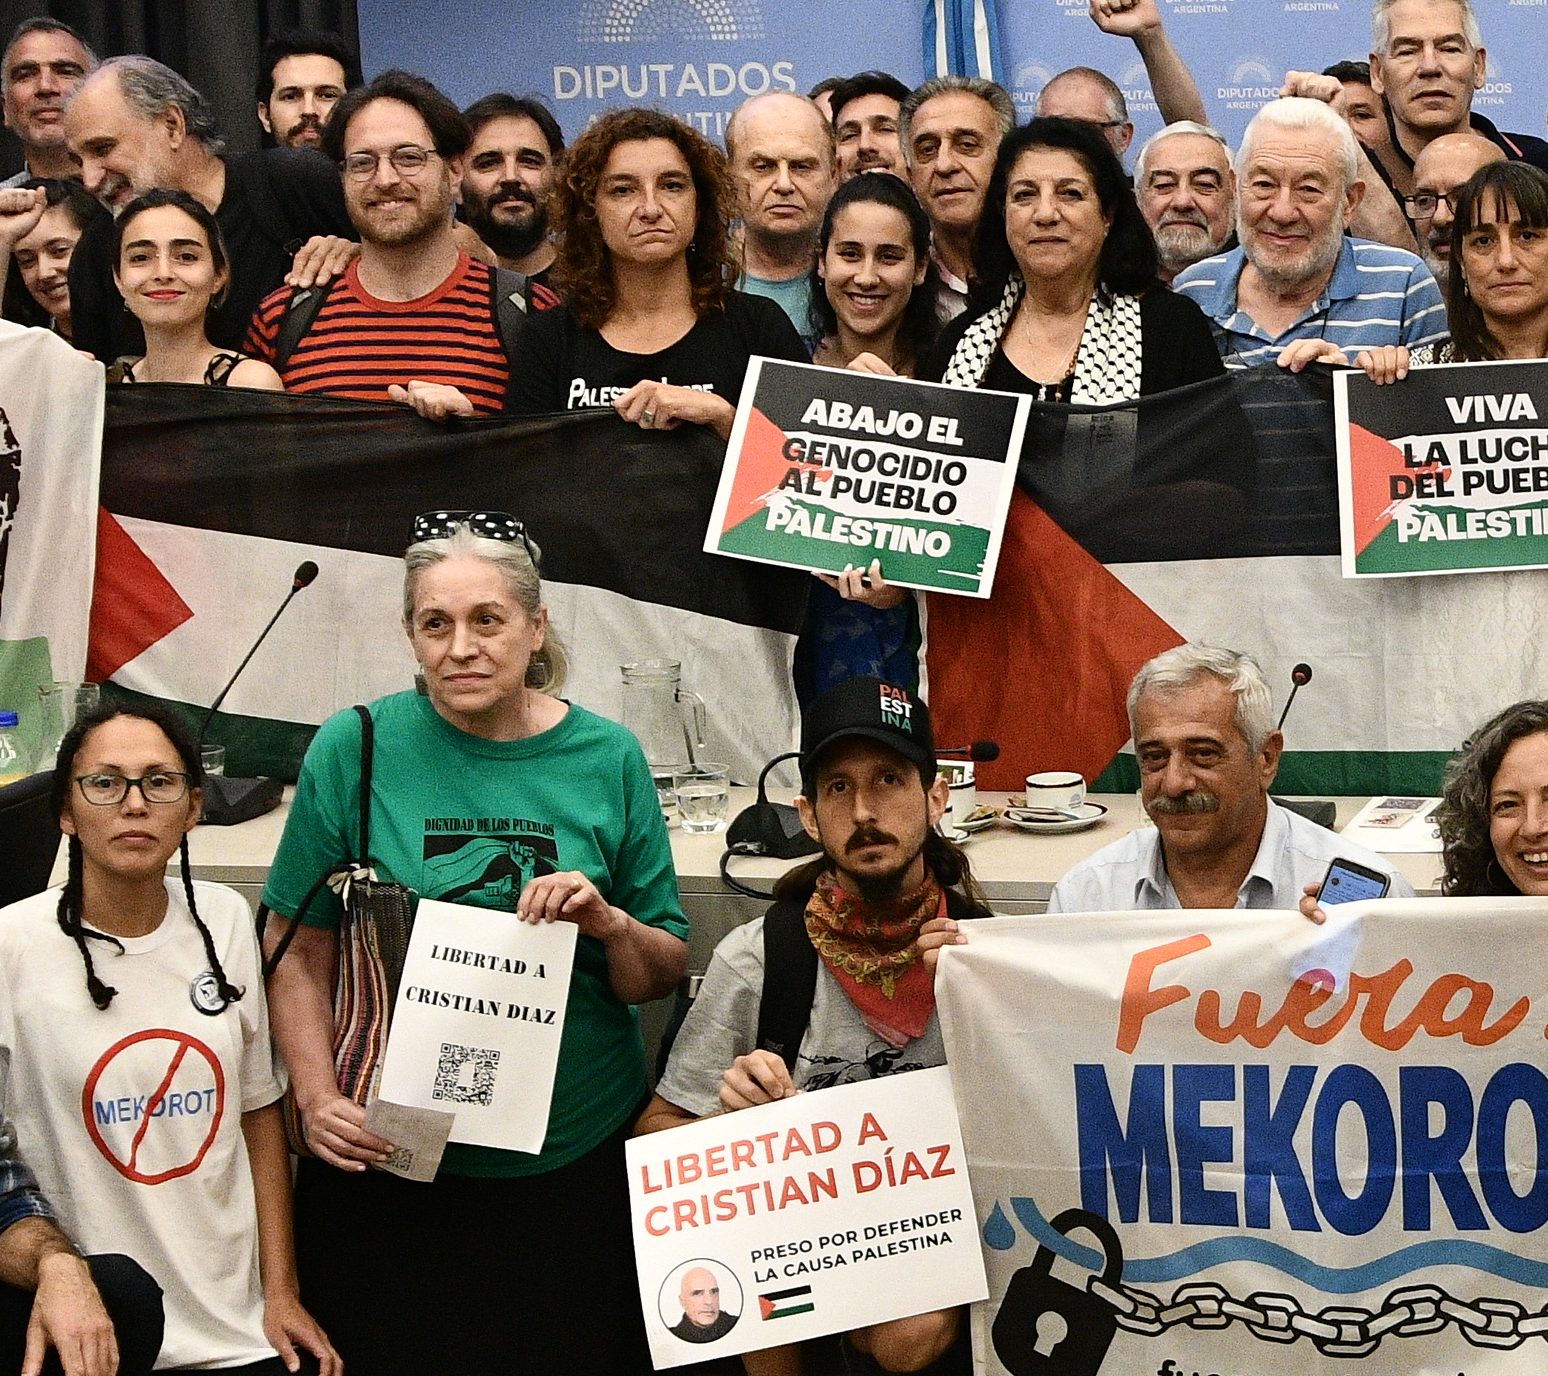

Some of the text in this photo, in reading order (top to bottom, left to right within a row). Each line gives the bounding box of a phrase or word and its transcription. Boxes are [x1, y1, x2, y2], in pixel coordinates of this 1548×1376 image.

[1174, 5, 1227, 13] ARGENTINA
[553, 62, 797, 99] DIPUTADOS
[1217, 87, 1281, 99] DIPUTADO
[801, 398, 964, 447] ABAJO EL
[1445, 393, 1538, 424] VIVA
[782, 437, 967, 487] GENOCIDIO
[1403, 441, 1451, 469] LA
[778, 468, 957, 516] AL PUEBLO
[1389, 471, 1455, 500] DEL
[765, 501, 951, 558] PALESTINO
[880, 684, 912, 704] PAL
[880, 696, 913, 718] EST
[881, 711, 913, 734] INA
[424, 817, 555, 836] DIGNIDAD DE LOS PUEBLOS
[431, 944, 547, 979] LIBERTAD A
[405, 986, 557, 1026] CRISTIAN DIAZ
[95, 1088, 216, 1125] MEKOROT
[640, 1112, 888, 1195] LIBERTAD A
[644, 1143, 956, 1237] CRISTIAN DÍAZ
[750, 1208, 963, 1263] PRESO POR DEFENDER
[754, 1231, 953, 1283] LA CAUSA PALESTINA
